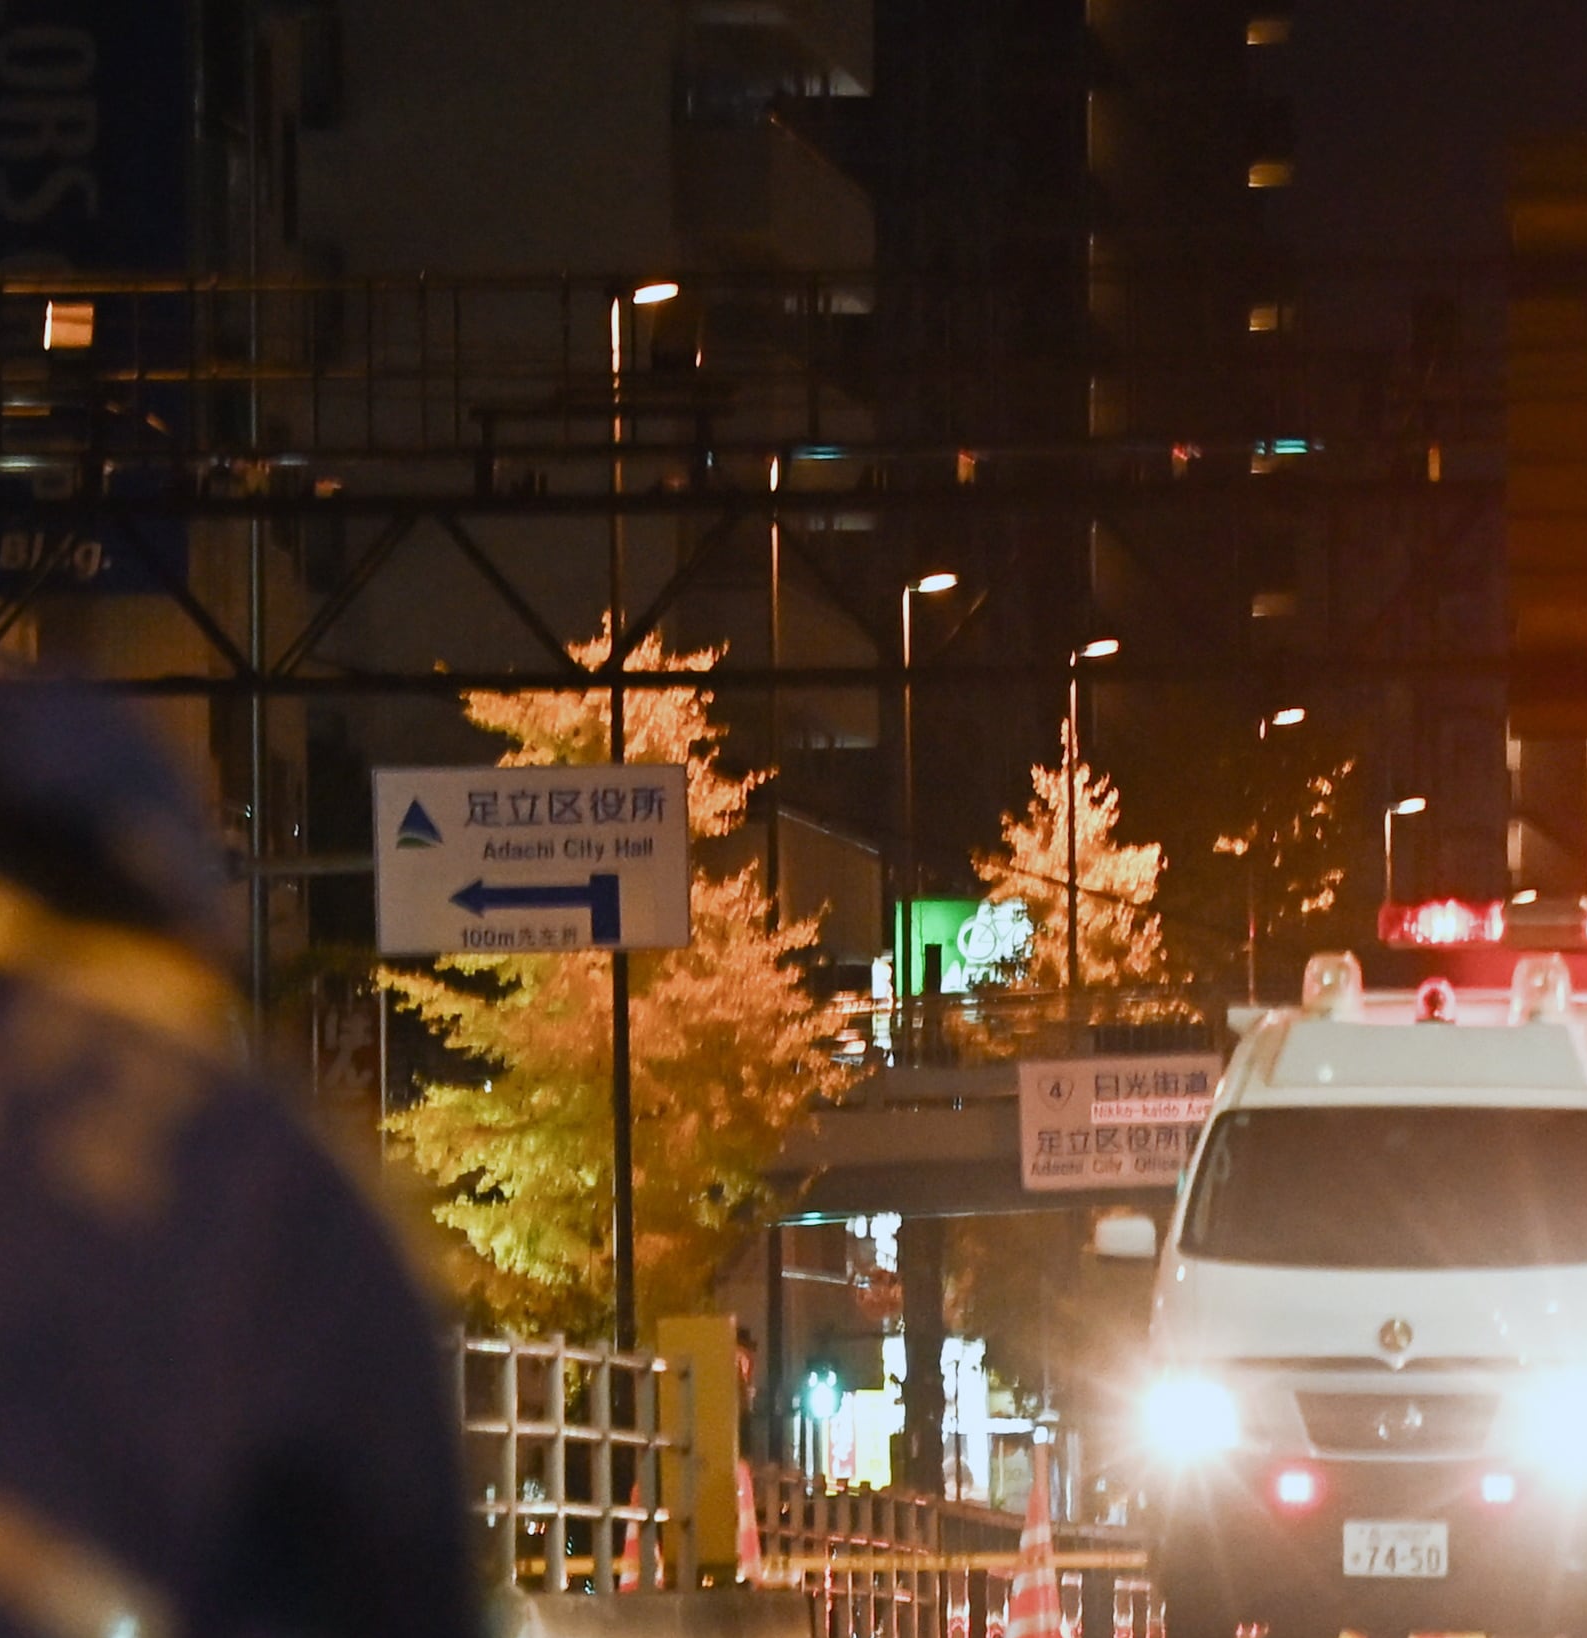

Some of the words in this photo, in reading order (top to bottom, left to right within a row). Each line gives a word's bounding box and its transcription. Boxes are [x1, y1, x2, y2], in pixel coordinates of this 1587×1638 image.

[464, 786, 666, 828] 足立区役所
[483, 839, 554, 861] Adachi
[563, 838, 604, 863] City
[615, 837, 654, 859] Hall
[1049, 1081, 1062, 1098] 4
[1094, 1069, 1209, 1100] 日光街道
